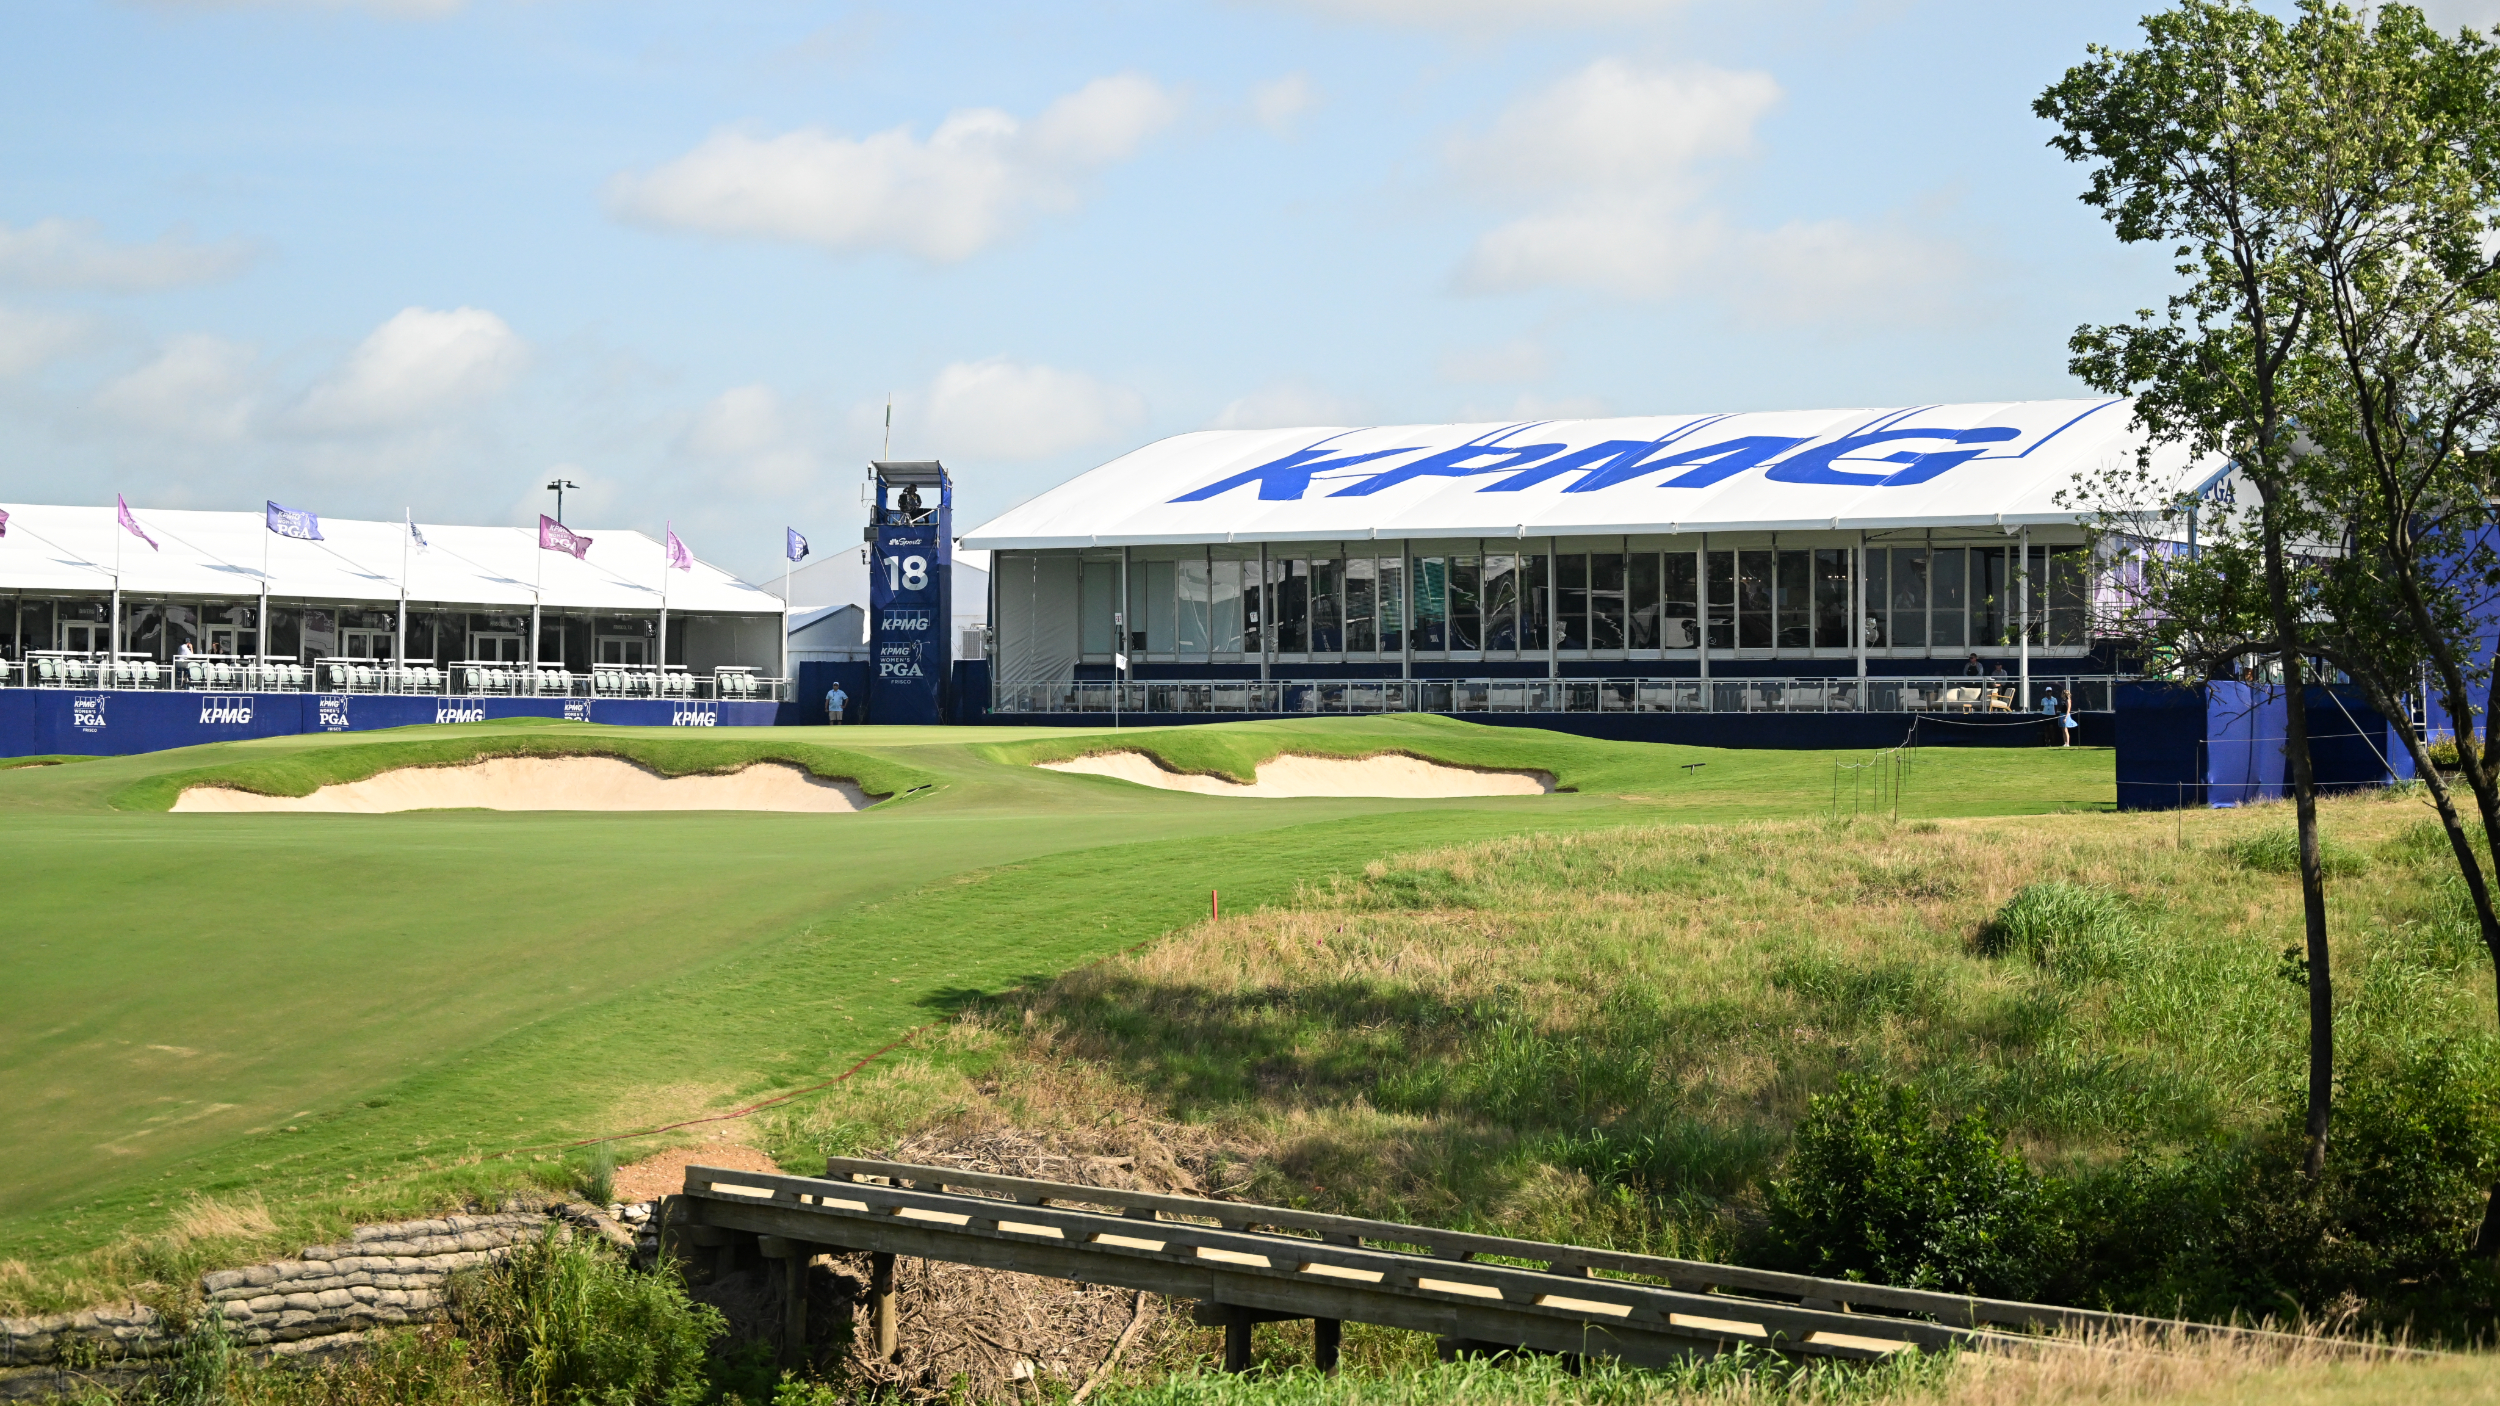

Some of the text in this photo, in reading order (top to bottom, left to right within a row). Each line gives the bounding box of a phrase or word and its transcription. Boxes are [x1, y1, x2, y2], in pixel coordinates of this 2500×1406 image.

[1166, 426, 2022, 503] KPMG
[277, 524, 311, 539] PGA
[899, 538, 922, 546] Sports
[884, 555, 928, 591] 18
[881, 618, 929, 631] KPMG
[880, 647, 910, 655] KPMG
[879, 662, 924, 677] PGA
[74, 700, 96, 708] KPMG
[319, 700, 340, 708] KPMG
[564, 704, 583, 712] KPMG
[74, 713, 107, 726] PGA
[199, 707, 251, 724] KPMG
[319, 713, 349, 726] PGA
[435, 708, 484, 724] KPMG
[672, 711, 716, 727] KPMG
